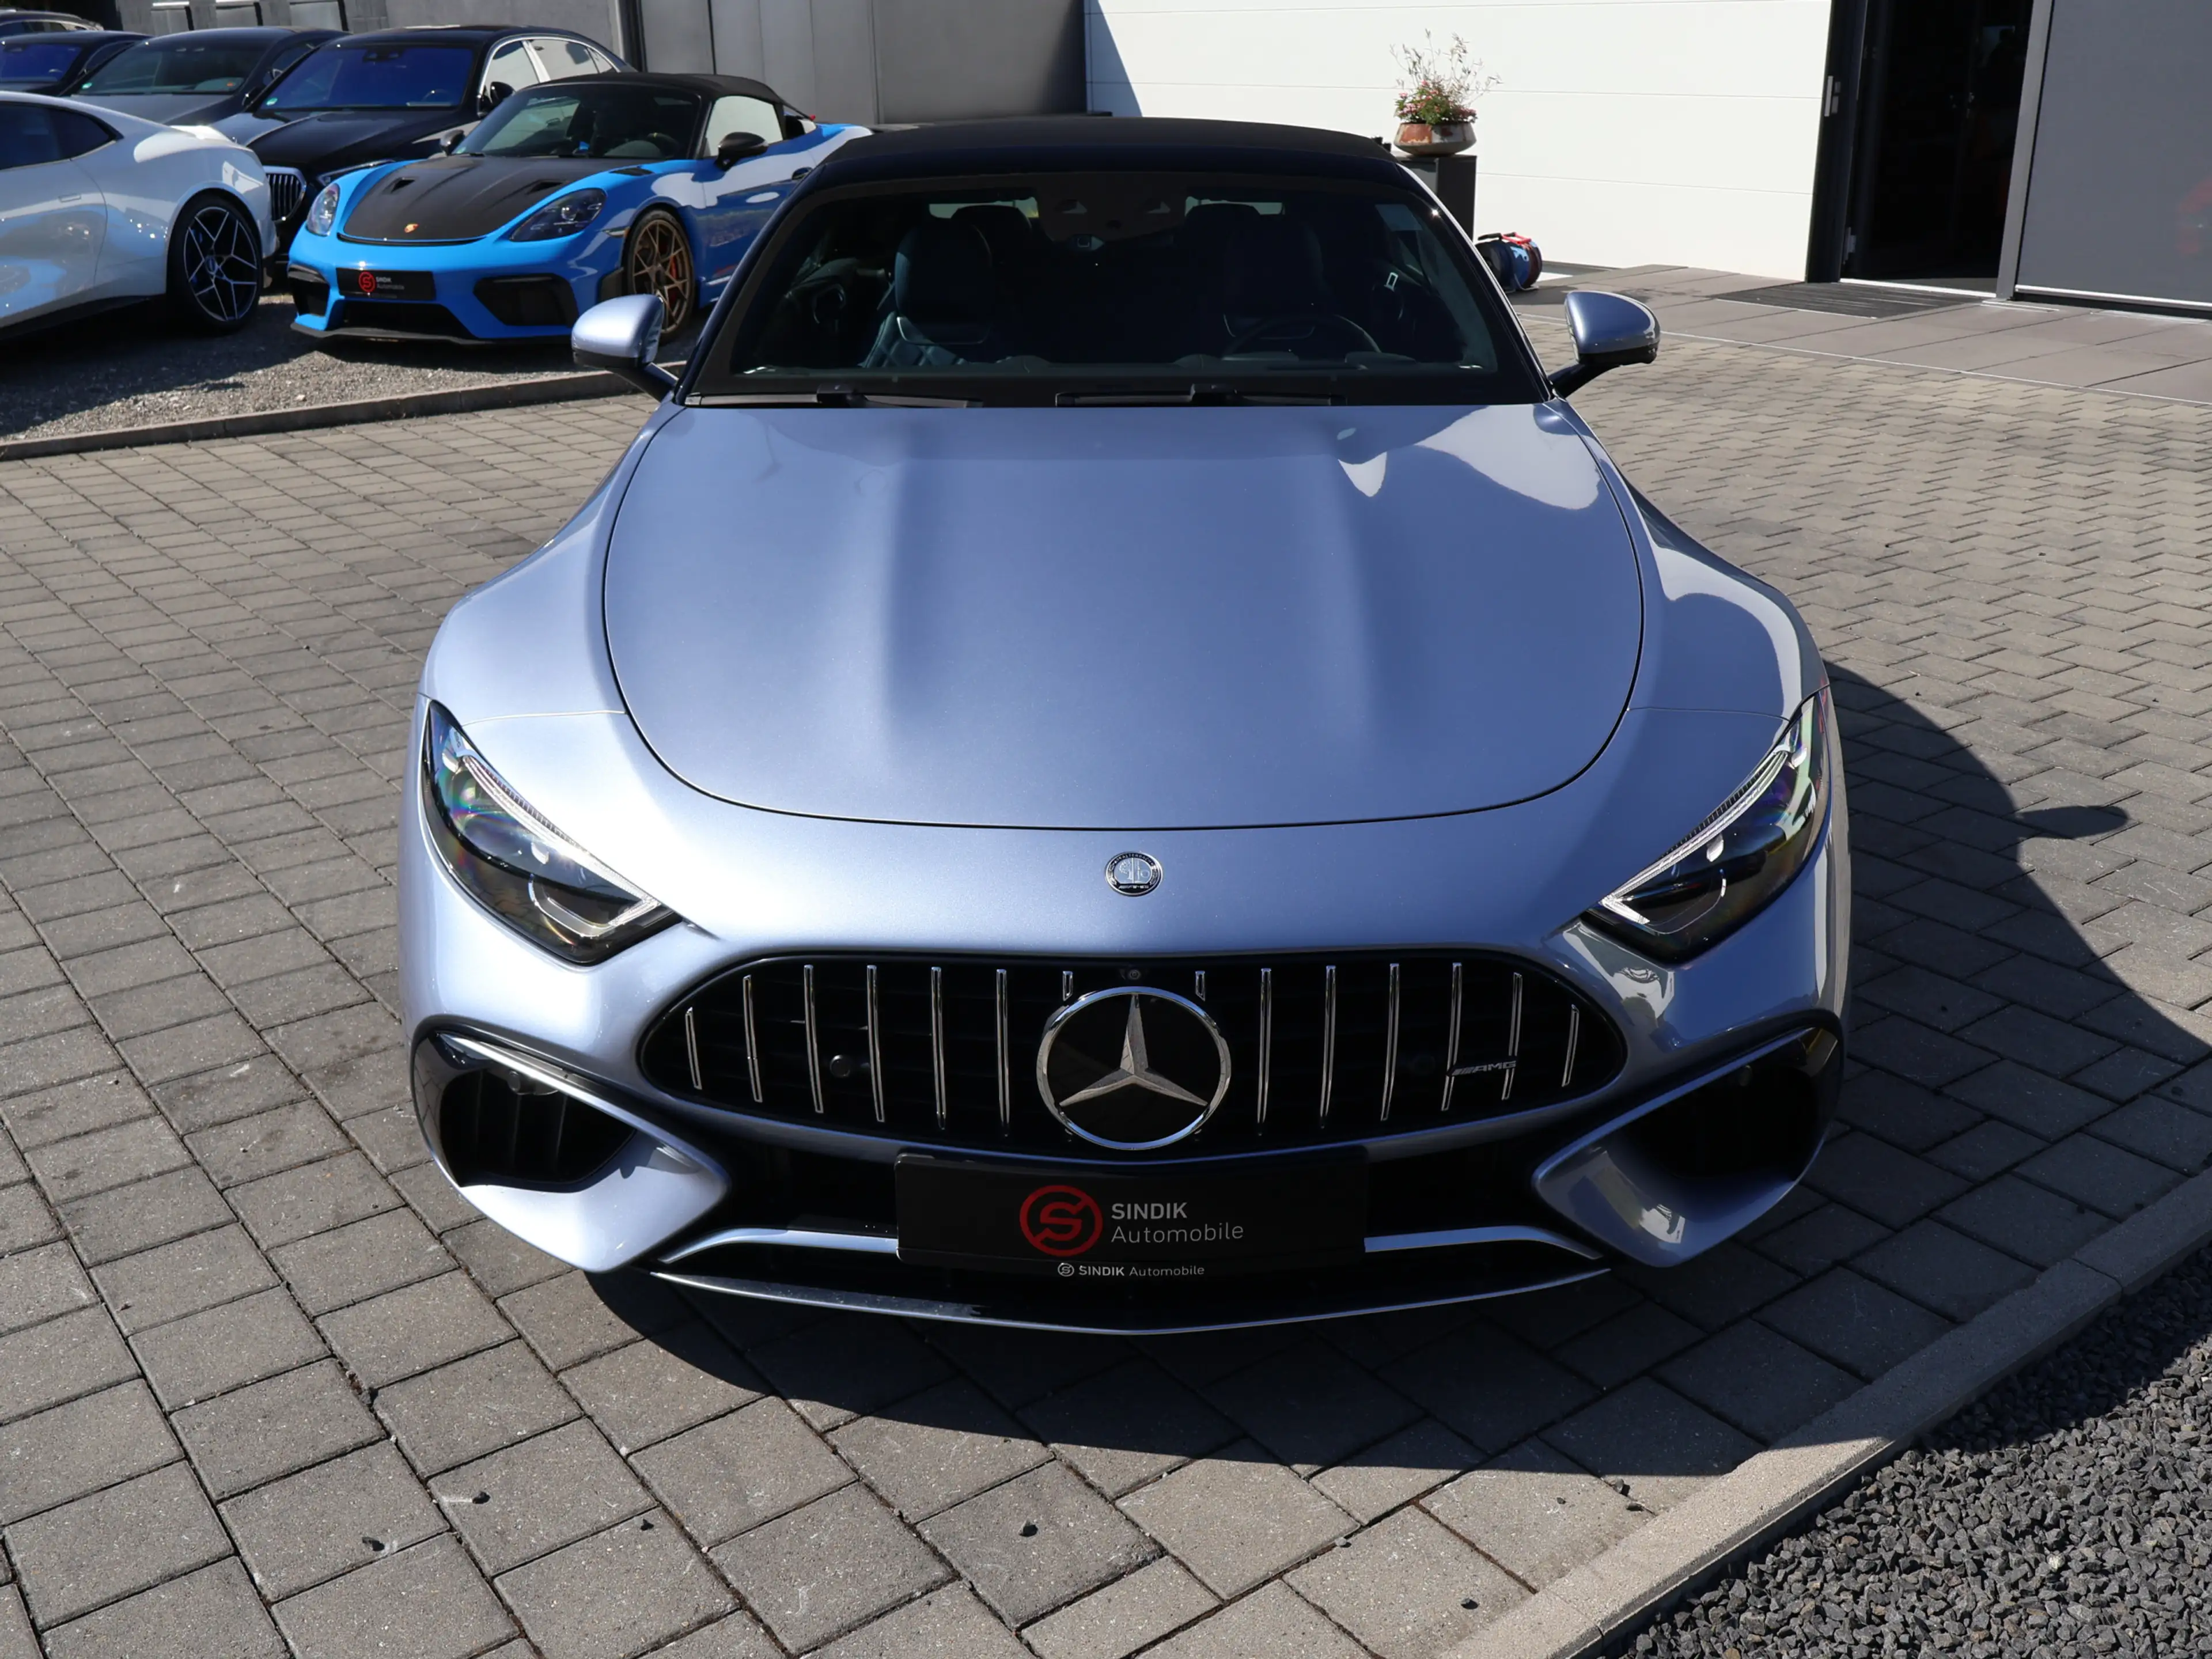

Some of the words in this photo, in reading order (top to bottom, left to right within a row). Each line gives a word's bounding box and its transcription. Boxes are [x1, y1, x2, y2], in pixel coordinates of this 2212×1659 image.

[1111, 1202, 1188, 1220] SINDIK
[1111, 1222, 1244, 1244] Automobile
[1078, 1265, 1125, 1277] SINDIK
[1128, 1265, 1205, 1277] Automobile
